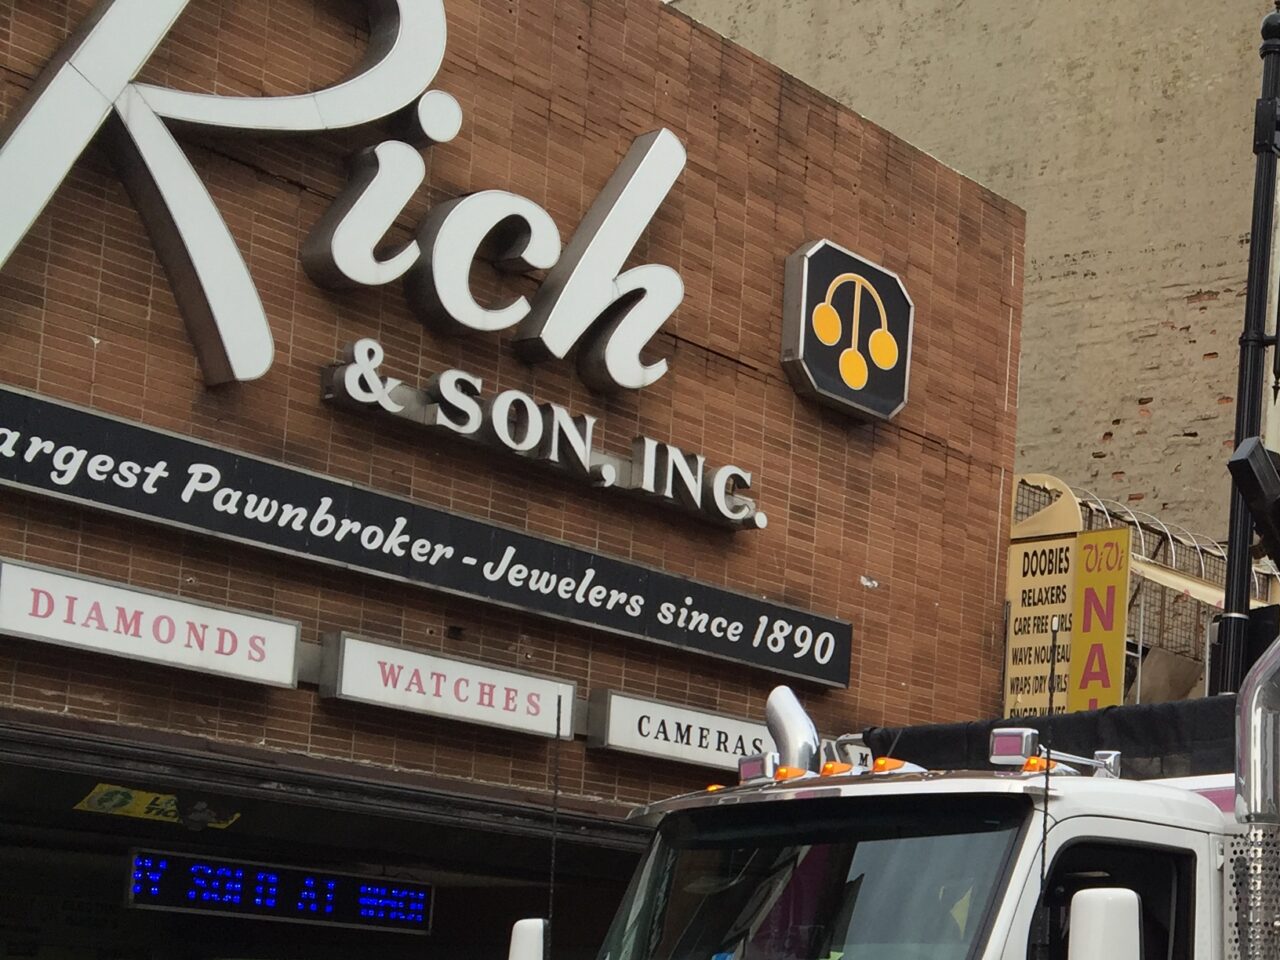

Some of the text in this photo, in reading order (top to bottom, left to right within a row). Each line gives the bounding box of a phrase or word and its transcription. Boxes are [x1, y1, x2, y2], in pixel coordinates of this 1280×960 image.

[0, 0, 687, 389] Rich
[344, 338, 768, 529] & SON, INC.
[1022, 546, 1070, 578] DOOBIES
[1021, 585, 1067, 608] RELAXERS
[28, 587, 267, 663] DIAMONDS
[657, 597, 744, 642] since
[752, 615, 835, 665] 1890
[1013, 617, 1031, 636] CARE
[1032, 615, 1048, 635] FREE
[1079, 585, 1116, 712] NA
[1012, 643, 1071, 666] WAVE NOUEAU
[377, 660, 542, 718] WATCHES
[1010, 676, 1031, 696] WRAPS
[637, 714, 765, 757] CAMERAS
